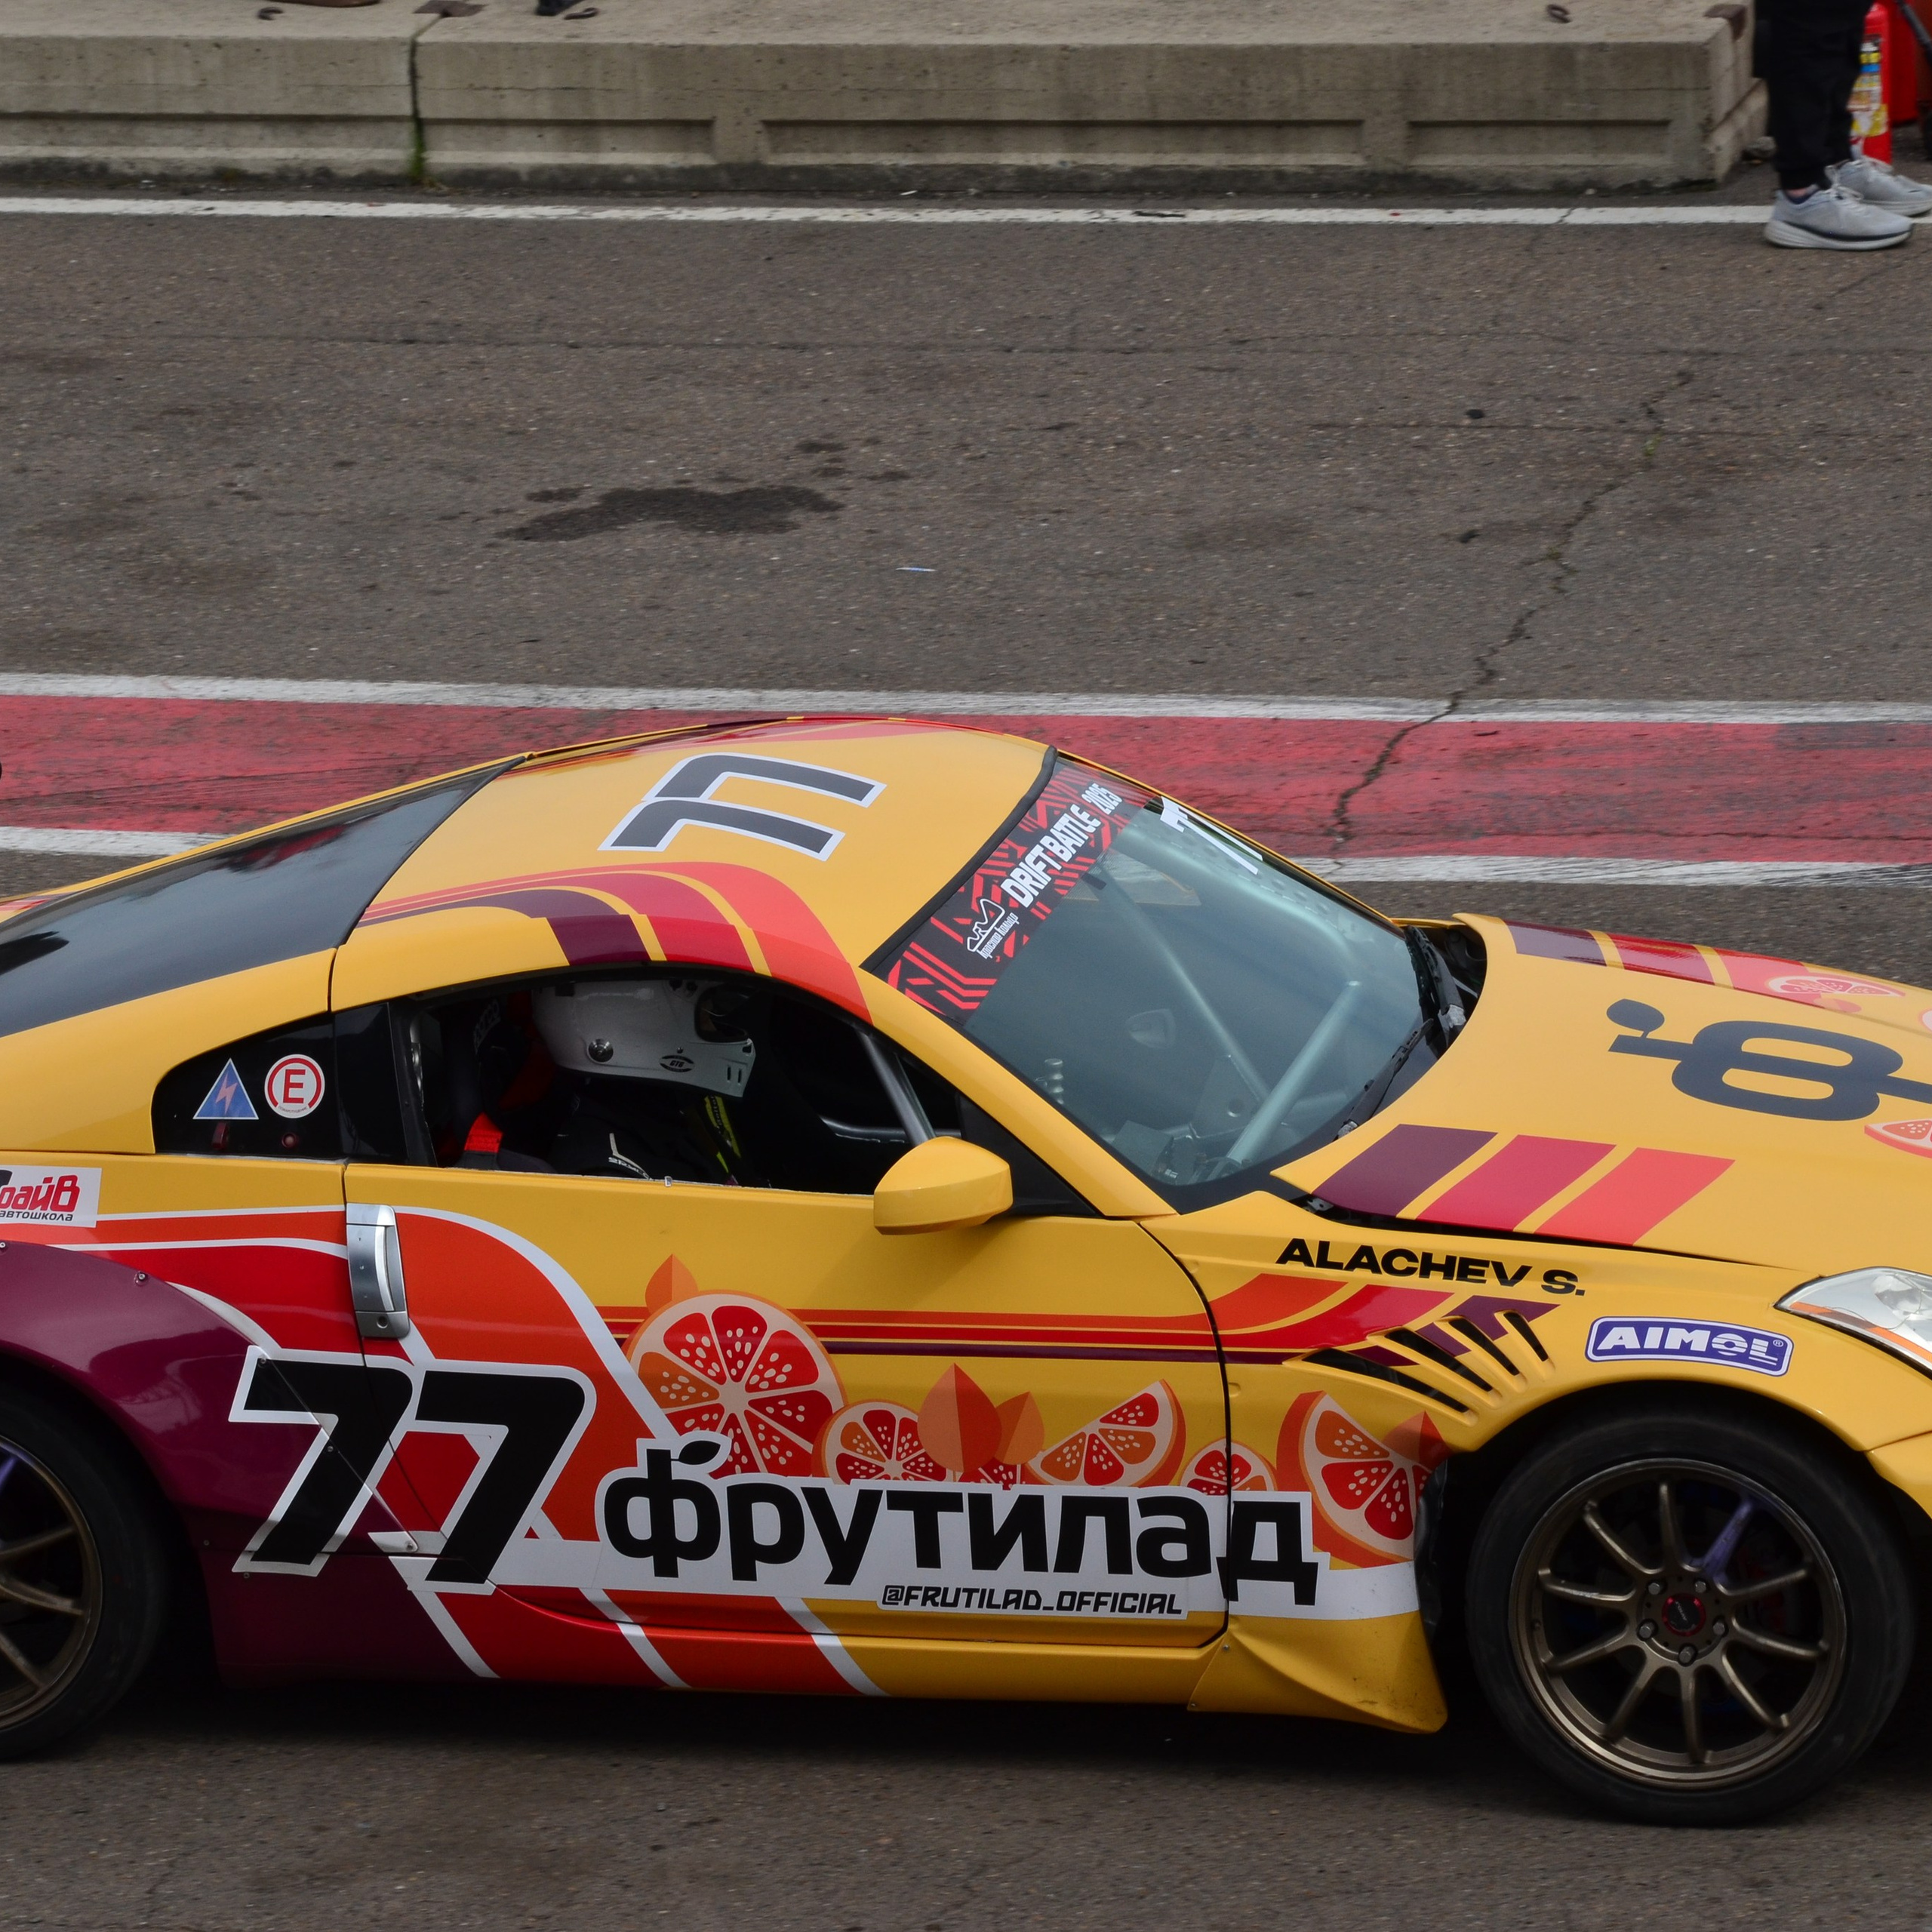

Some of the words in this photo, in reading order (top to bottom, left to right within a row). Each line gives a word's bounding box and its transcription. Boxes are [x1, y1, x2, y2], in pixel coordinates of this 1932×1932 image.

[1000, 844, 1063, 908] DRIFT
[1039, 804, 1102, 863] BATTLE
[1081, 783, 1123, 815] 2025
[283, 1069, 306, 1103] E
[0, 1210, 73, 1221] автошкола
[1275, 1238, 1533, 1287] ALACHEV
[1541, 1269, 1586, 1297] S.
[229, 1346, 596, 1595] 77
[881, 1585, 1183, 1615] @FRUTILAD_OFFICIAL
